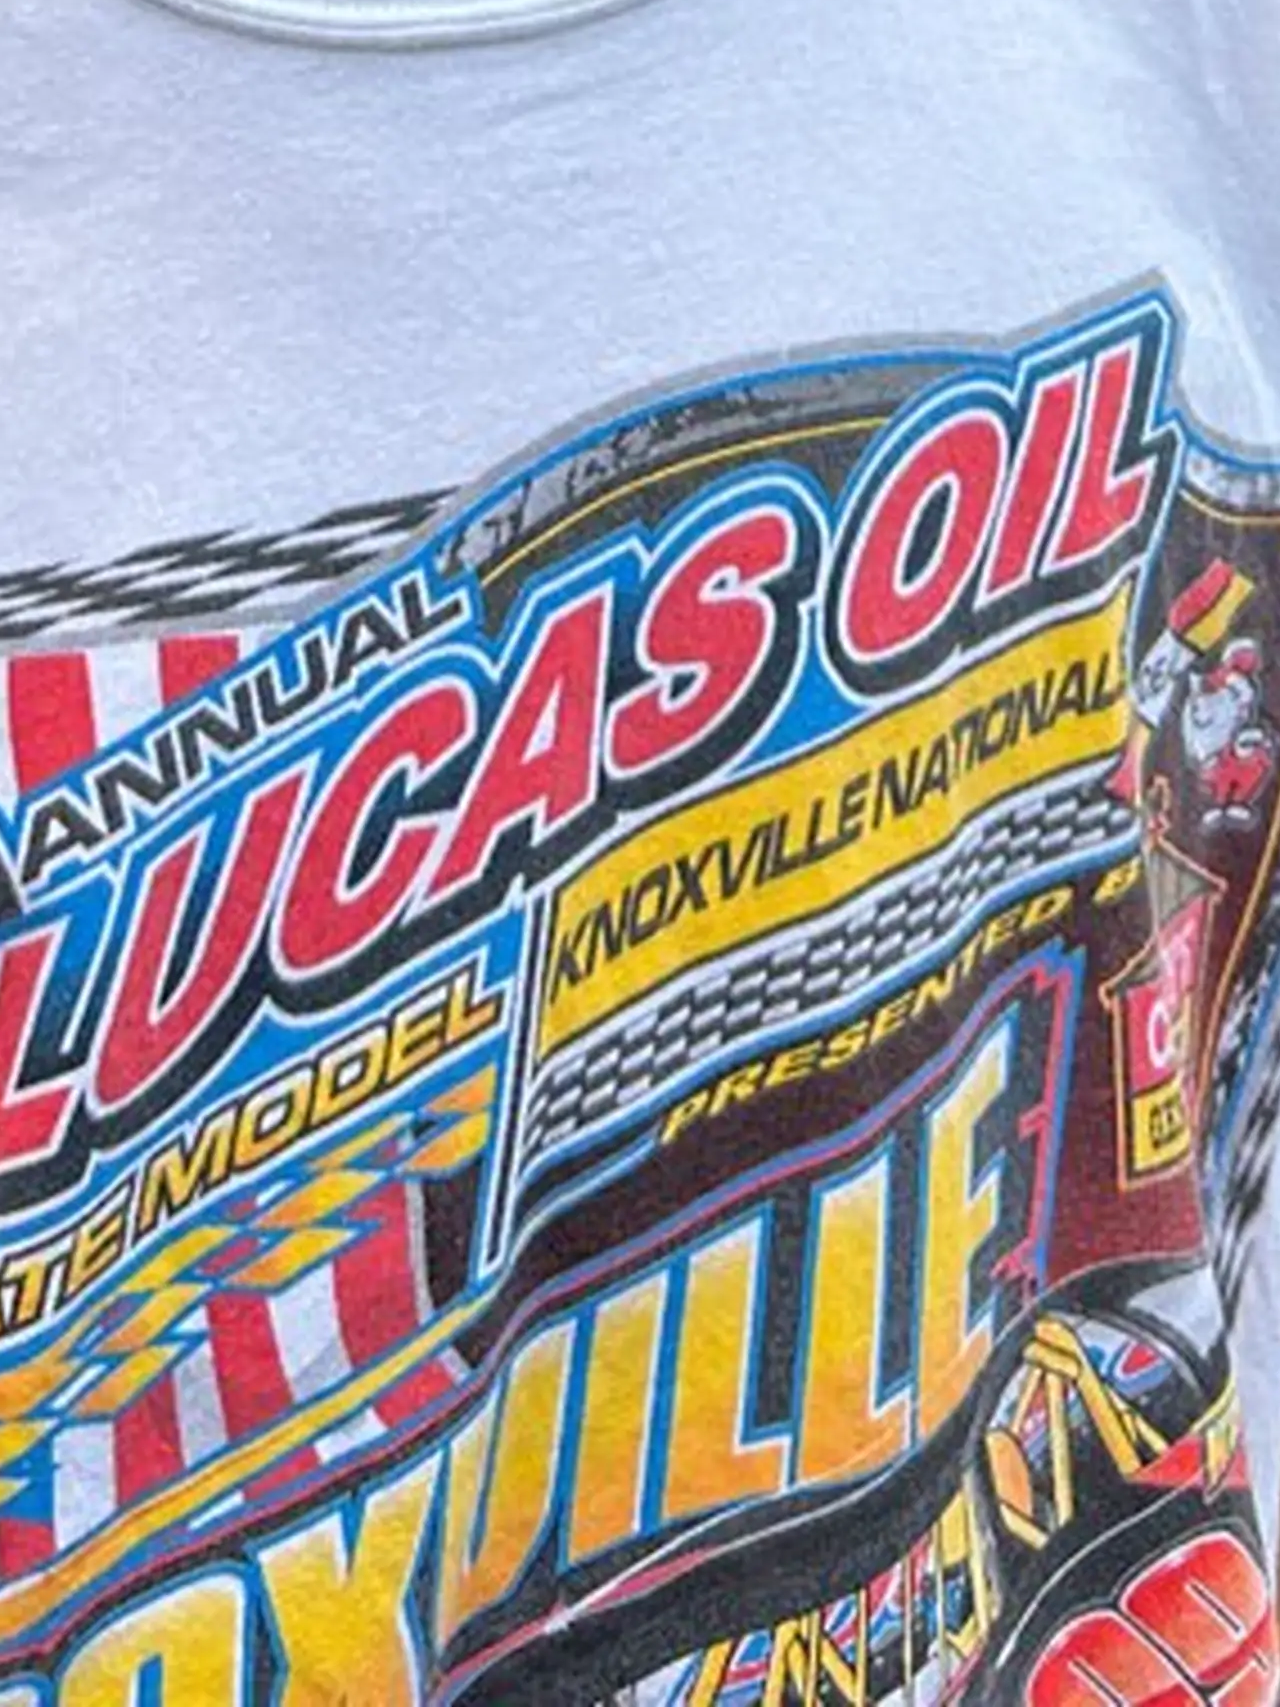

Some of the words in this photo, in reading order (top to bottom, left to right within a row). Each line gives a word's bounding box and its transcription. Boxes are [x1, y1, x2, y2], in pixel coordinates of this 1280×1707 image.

[836, 337, 1156, 661] OIL
[20, 577, 466, 887] ANNUAL
[547, 769, 871, 1006] KNOXVILLE
[657, 887, 1075, 1146] PRESENTED
[135, 965, 504, 1244] MODEL
